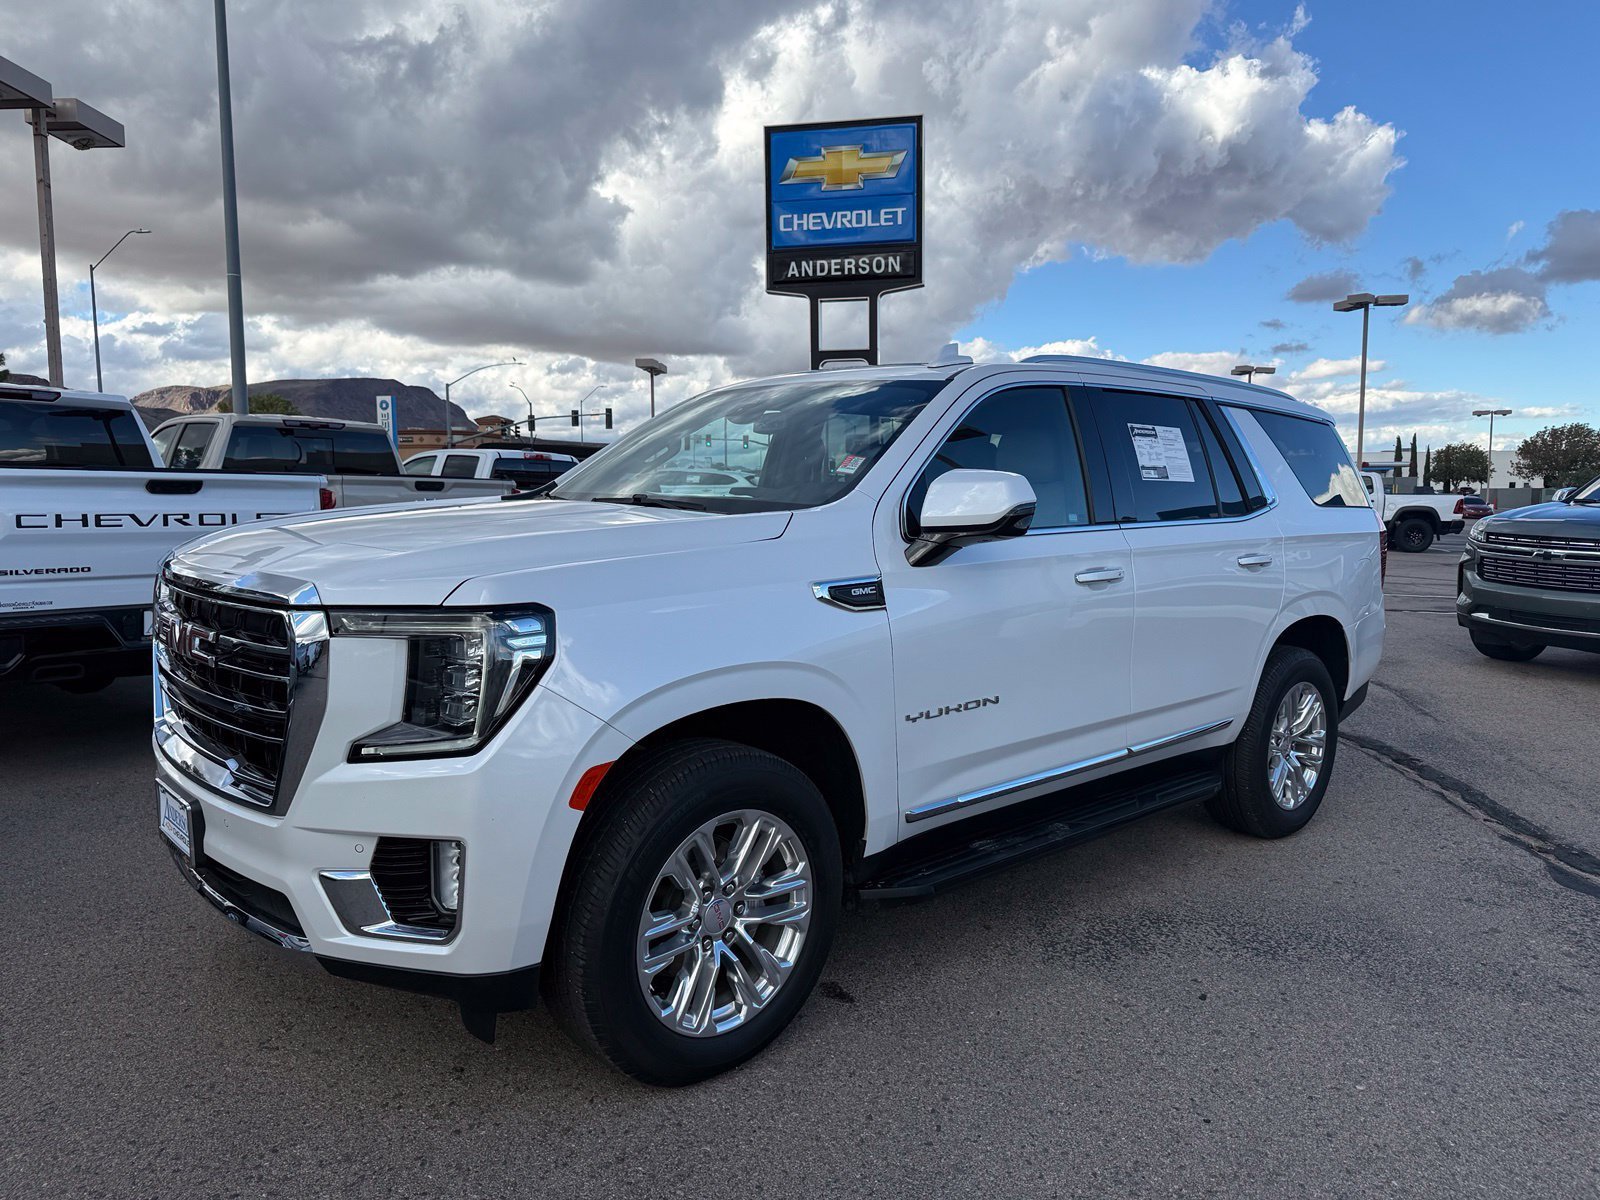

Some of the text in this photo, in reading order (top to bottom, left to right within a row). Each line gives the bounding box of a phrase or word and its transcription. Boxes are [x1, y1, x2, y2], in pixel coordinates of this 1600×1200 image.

[779, 207, 907, 232] CHEVROLET
[787, 255, 901, 277] ANDERSON
[0, 566, 92, 576] SILVERADO
[851, 586, 877, 596] GMC
[905, 695, 1000, 724] YUKON
